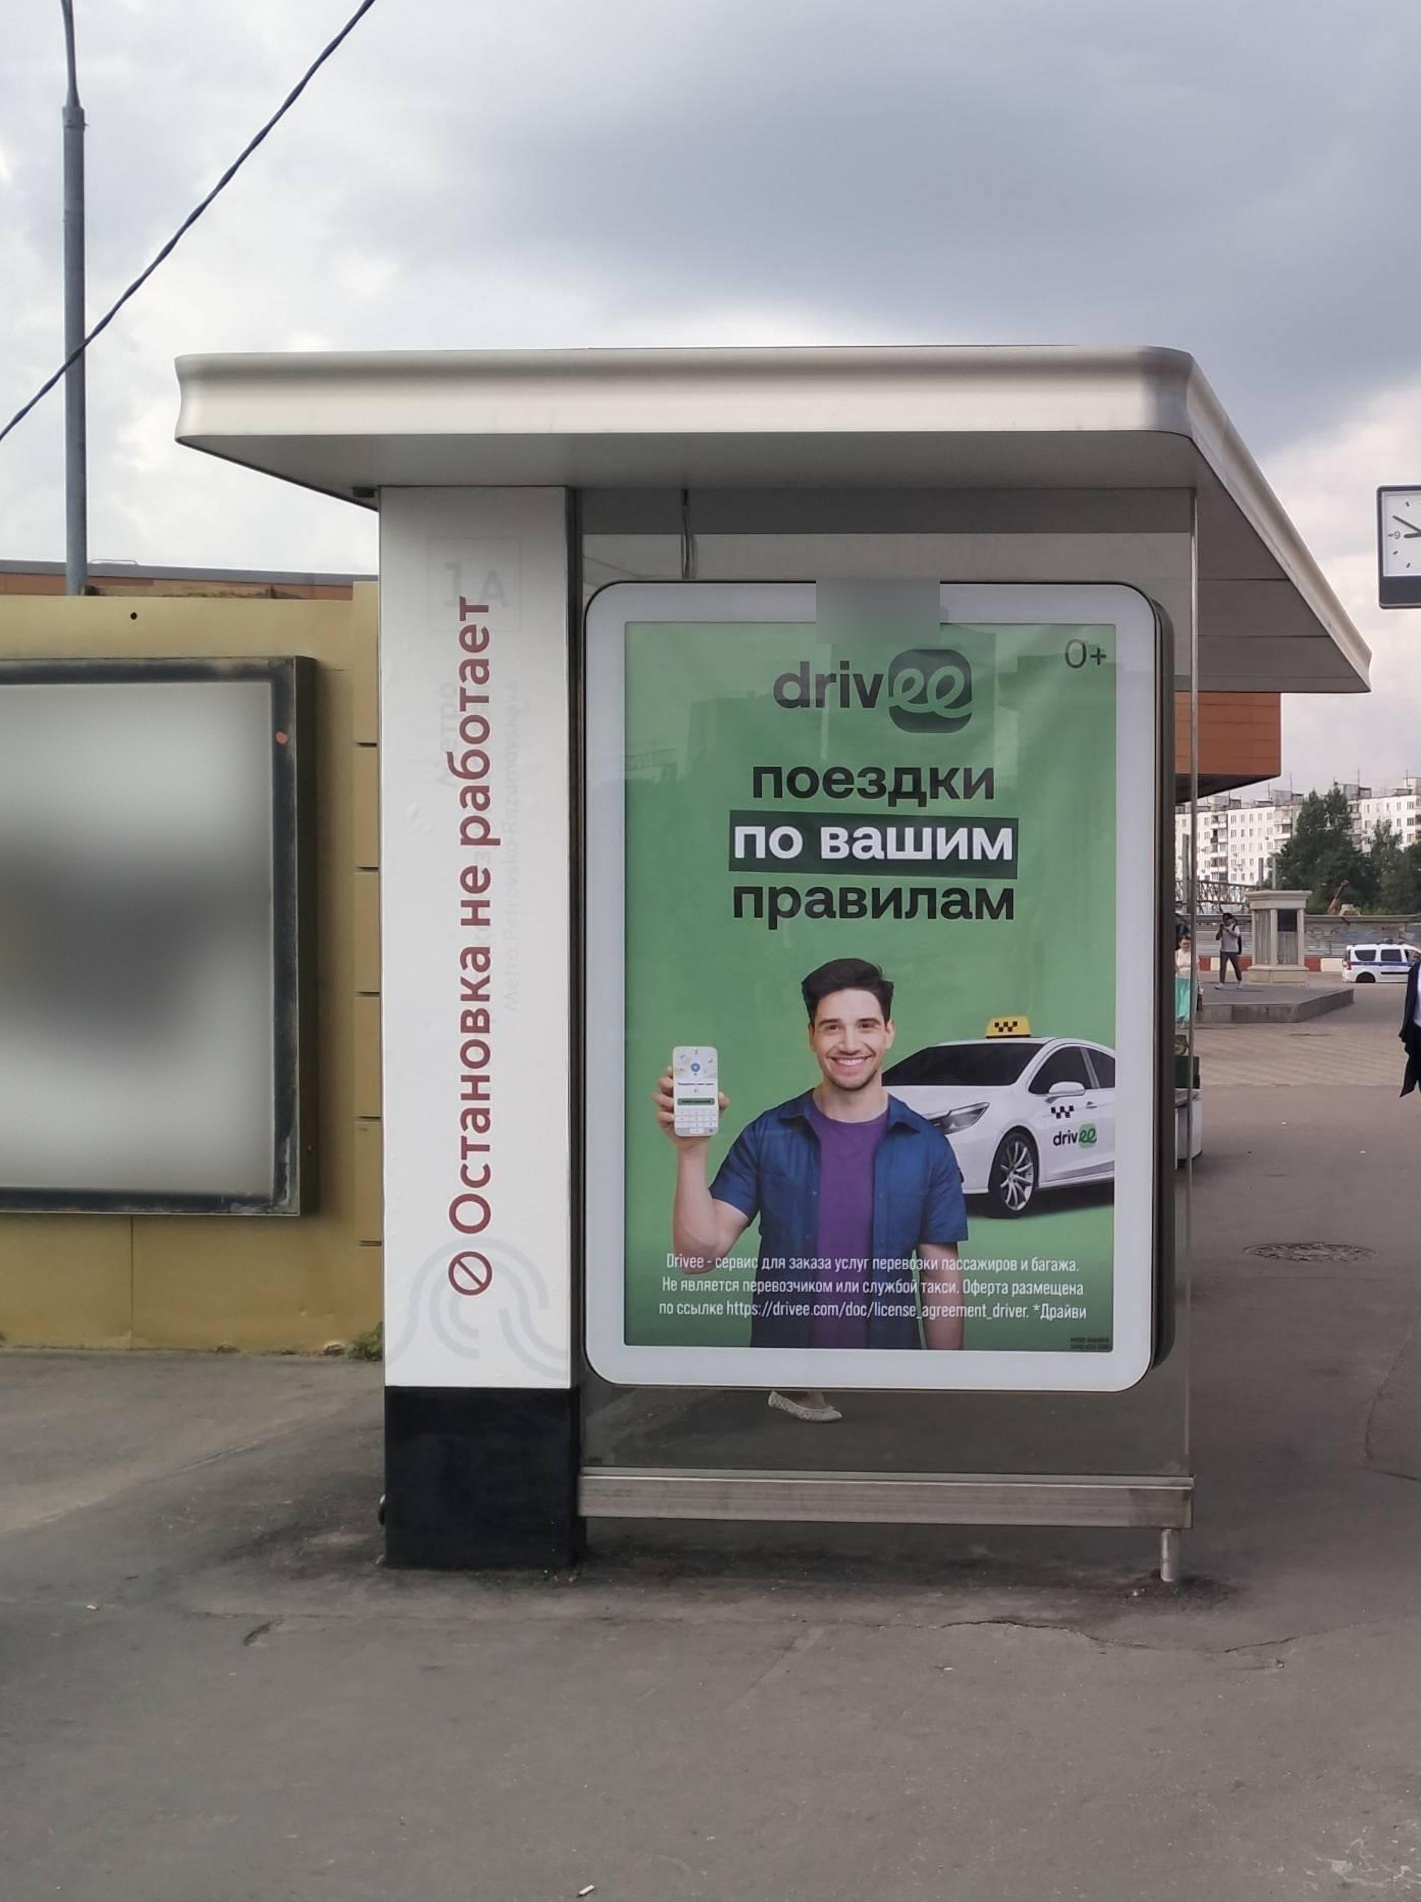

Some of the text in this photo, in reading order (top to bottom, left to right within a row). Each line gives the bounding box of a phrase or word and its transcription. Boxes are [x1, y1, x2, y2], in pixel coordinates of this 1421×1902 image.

[1394, 531, 1400, 539] 9
[1064, 638, 1107, 669] 0+
[773, 658, 973, 721] drivee
[752, 766, 995, 808] поездки
[733, 825, 1014, 861] по вашим
[446, 595, 501, 1233] Остановка не работает
[732, 884, 1015, 929] правилам
[1053, 1126, 1097, 1147] drivee
[666, 1254, 704, 1269] Drivee
[715, 1257, 758, 1272] сервис
[762, 1257, 786, 1272] для
[789, 1257, 831, 1270] заказа
[834, 1257, 869, 1273] услуг
[872, 1258, 938, 1273] перевозки
[941, 1258, 1017, 1274] пассажиров
[1021, 1259, 1028, 1271] и
[1031, 1257, 1079, 1272] багажа.
[663, 1278, 1084, 1299] Не является перевозчиком или службой такси. Оферта размещена
[659, 1302, 674, 1315] по
[677, 1302, 723, 1315] ссылке
